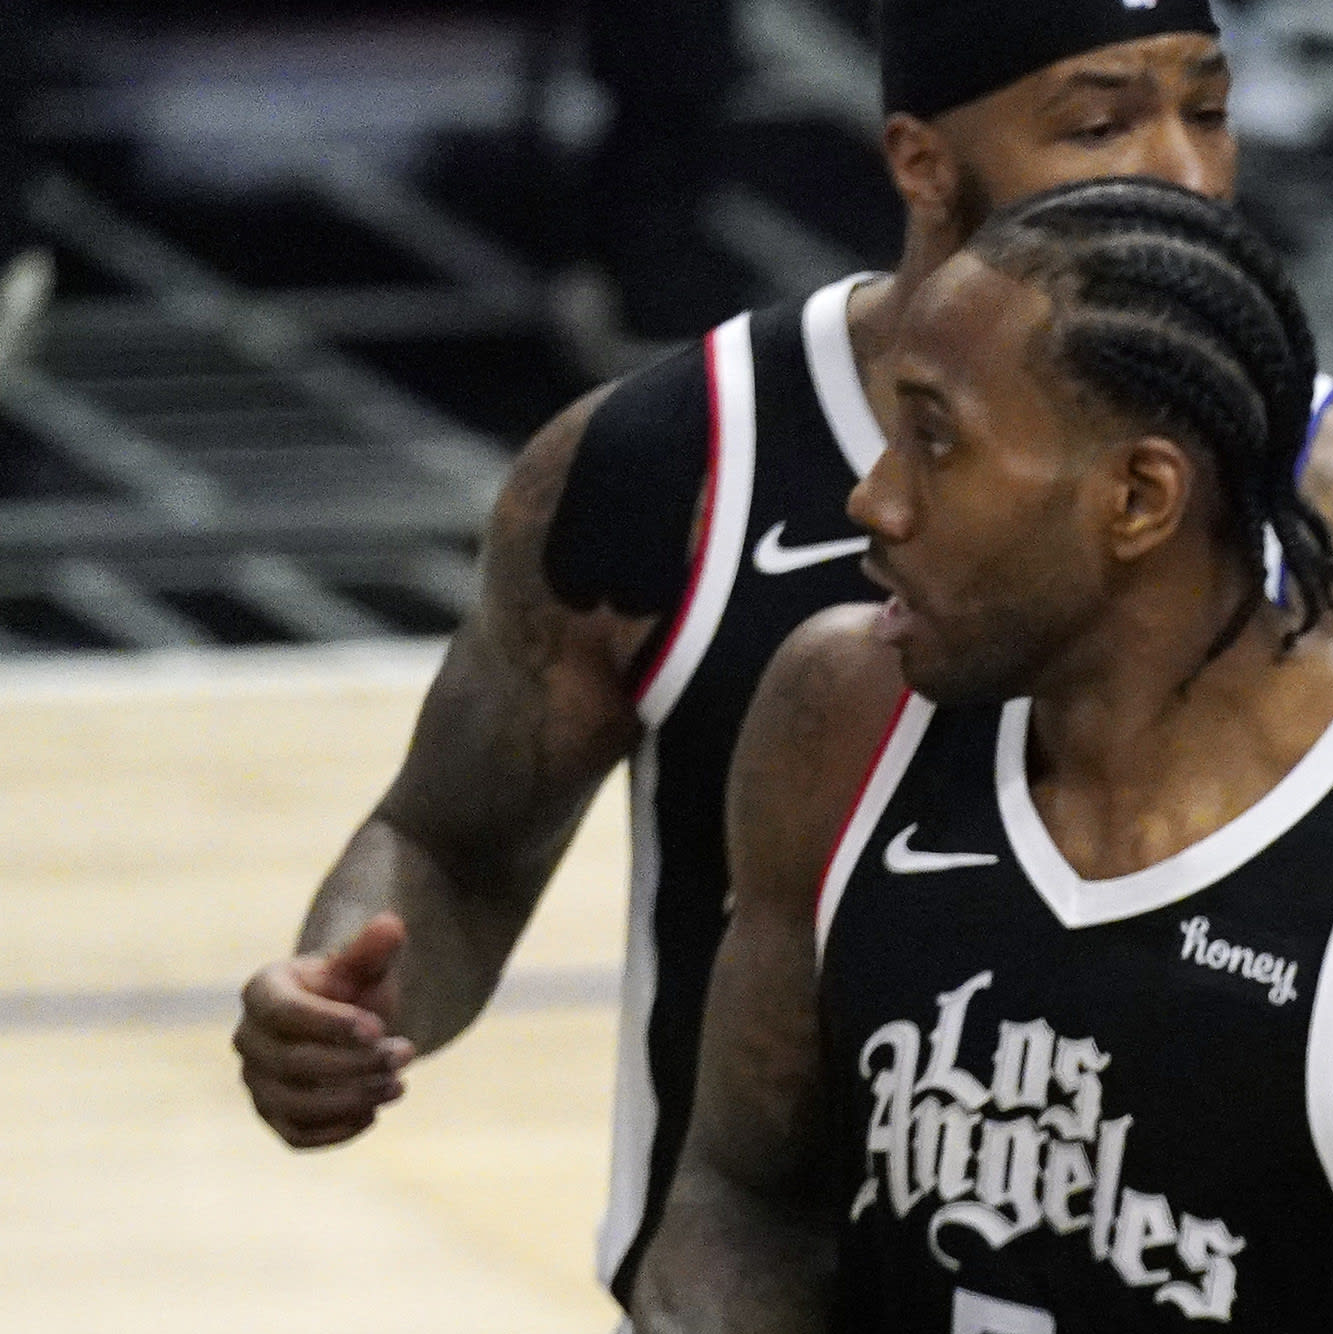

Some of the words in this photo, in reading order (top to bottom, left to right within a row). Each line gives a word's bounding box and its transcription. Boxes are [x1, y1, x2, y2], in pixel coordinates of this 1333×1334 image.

[1180, 914, 1298, 1005] honey
[912, 969, 1112, 1142] Los
[849, 1018, 1248, 1323] Angeles
